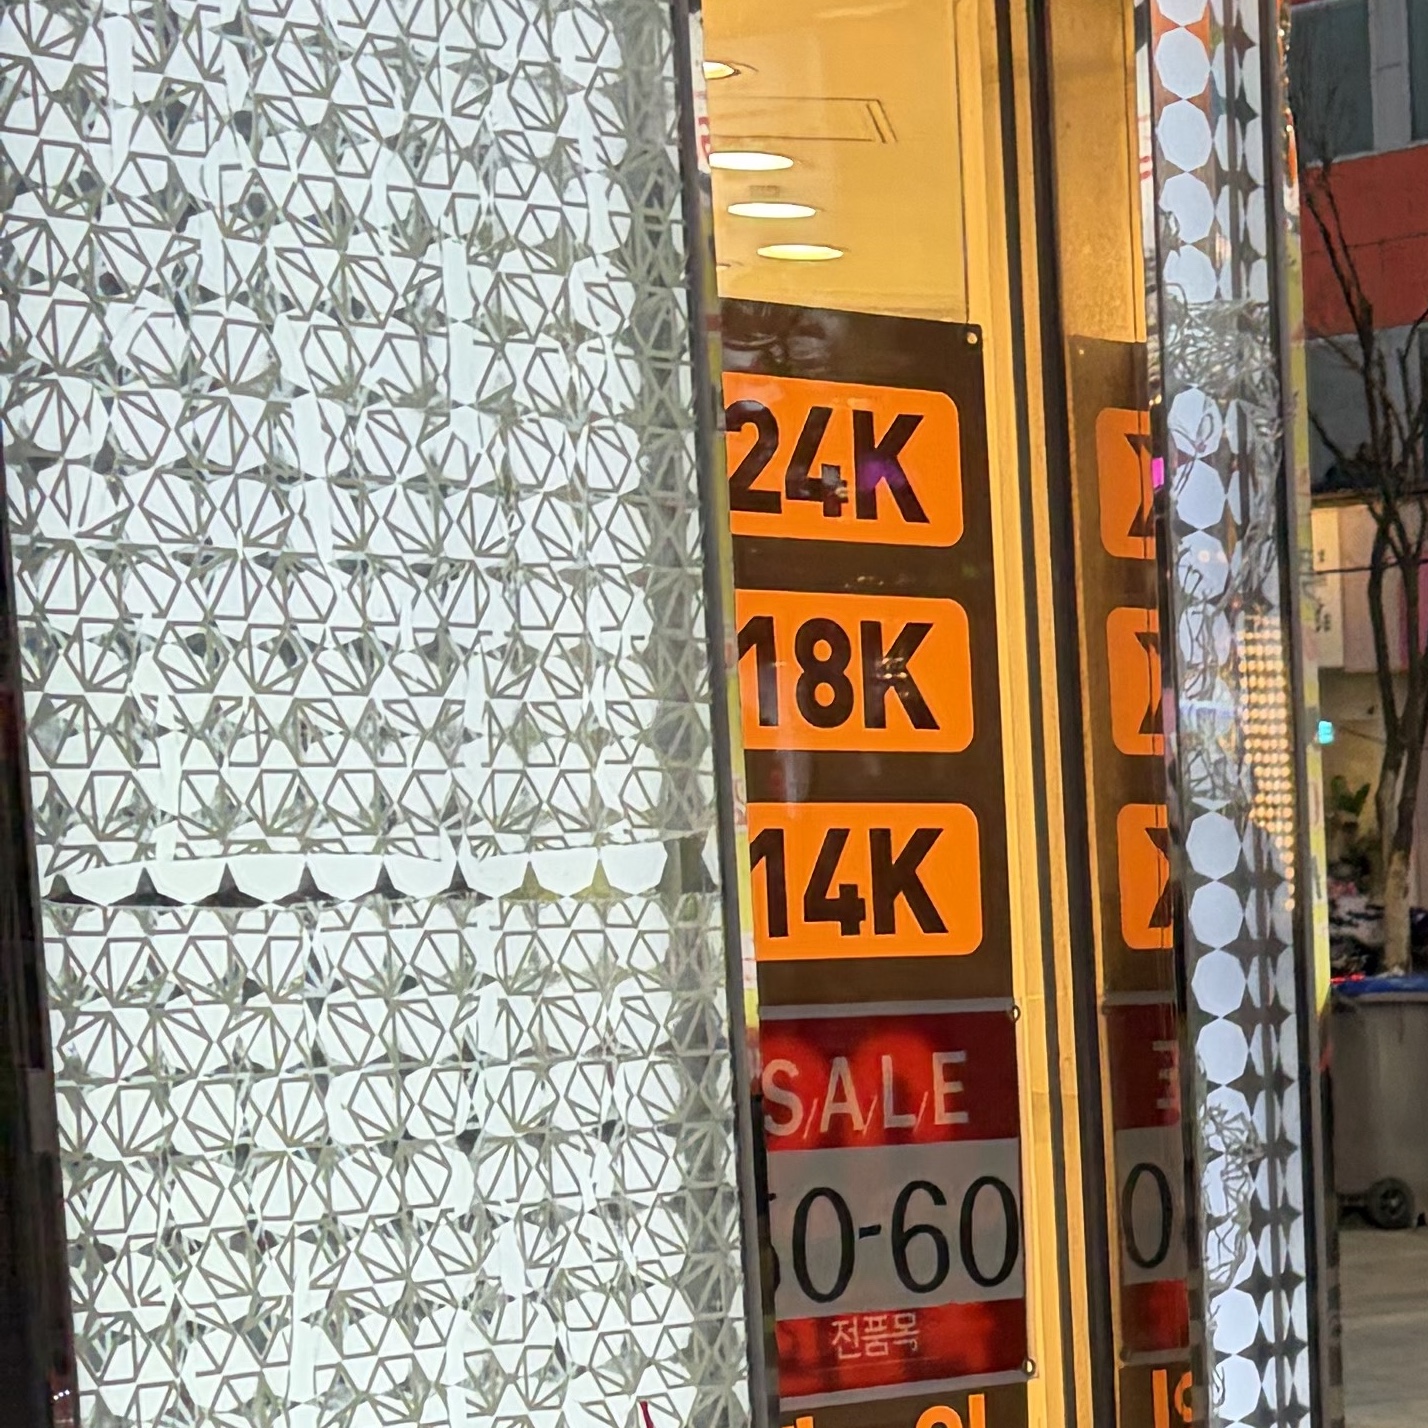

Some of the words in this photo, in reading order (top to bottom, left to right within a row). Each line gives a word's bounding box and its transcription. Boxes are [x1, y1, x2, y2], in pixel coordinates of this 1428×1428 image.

[725, 399, 930, 525] 24K
[738, 613, 941, 731] 18K
[749, 826, 950, 939] 14K
[760, 1048, 973, 1137] SALE
[830, 1310, 921, 1361] 전품목
